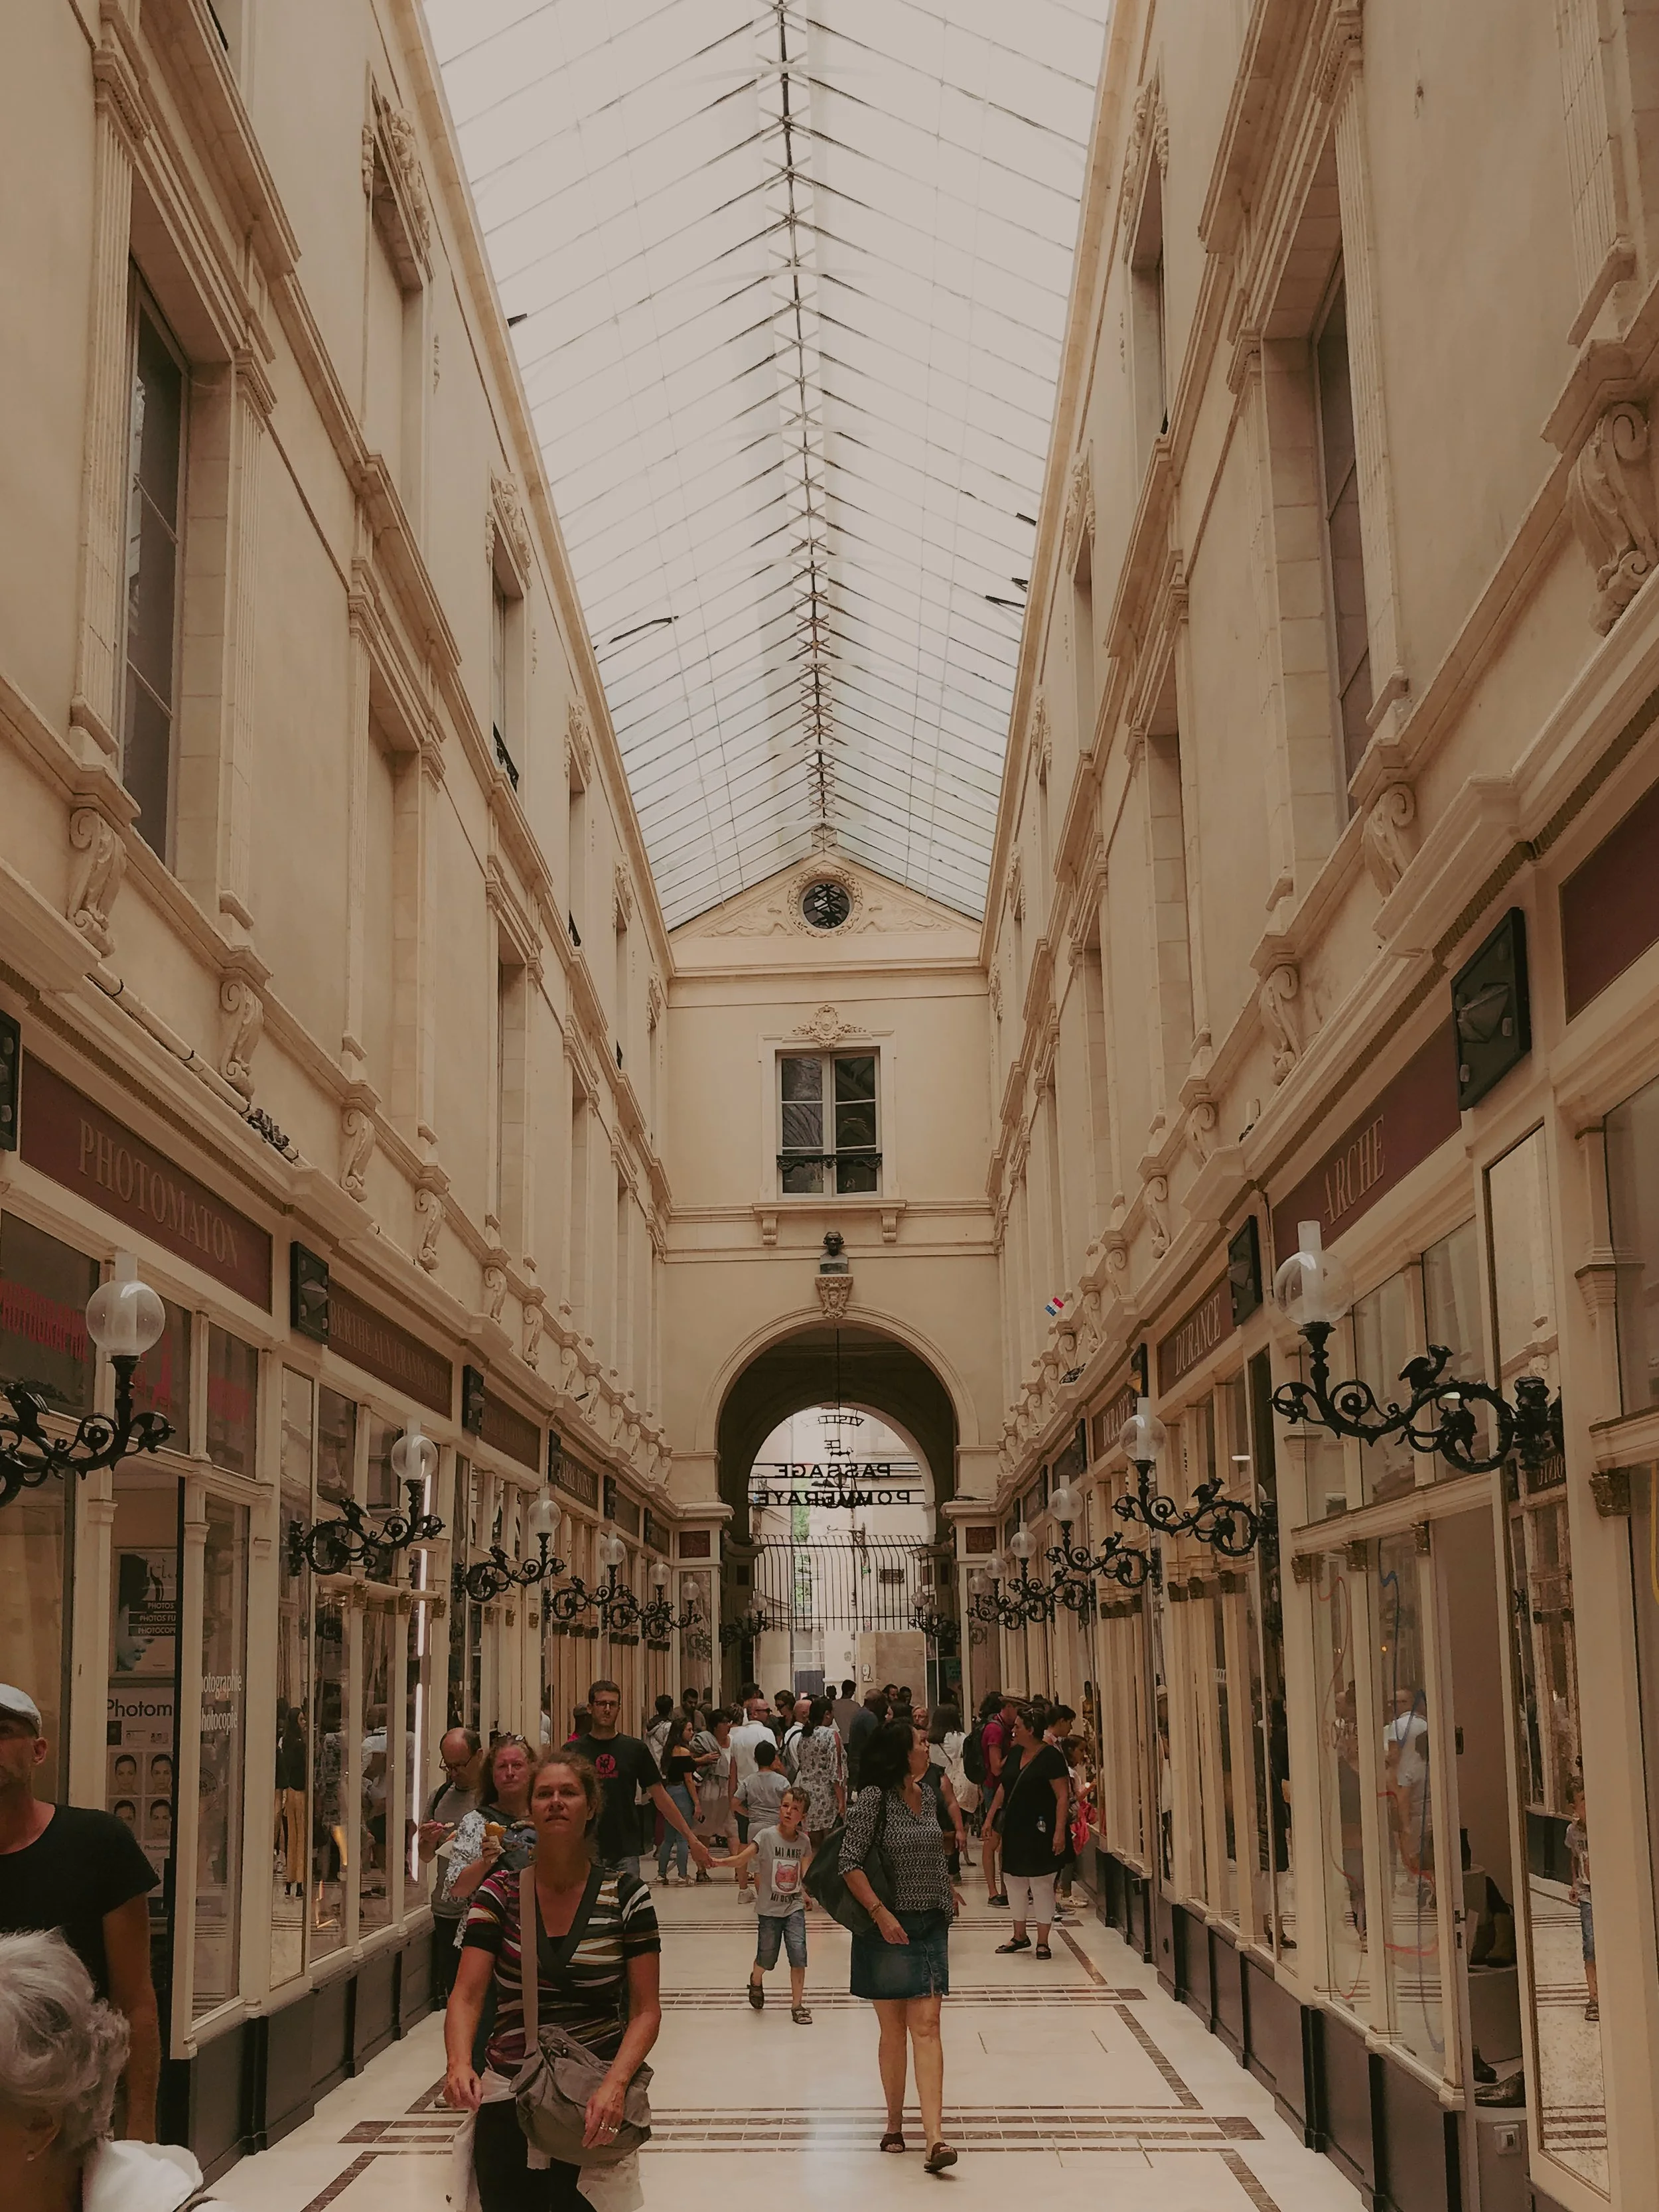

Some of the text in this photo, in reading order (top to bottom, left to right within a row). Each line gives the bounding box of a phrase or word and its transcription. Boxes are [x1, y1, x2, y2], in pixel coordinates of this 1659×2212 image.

[78, 1118, 238, 1269] PHOTOMATON
[1323, 1114, 1386, 1226] ARCHE
[330, 1300, 371, 1357] BERTHE
[1175, 1292, 1222, 1376] DURANCE
[775, 1846, 784, 1857] MI
[770, 1892, 779, 1902] MI
